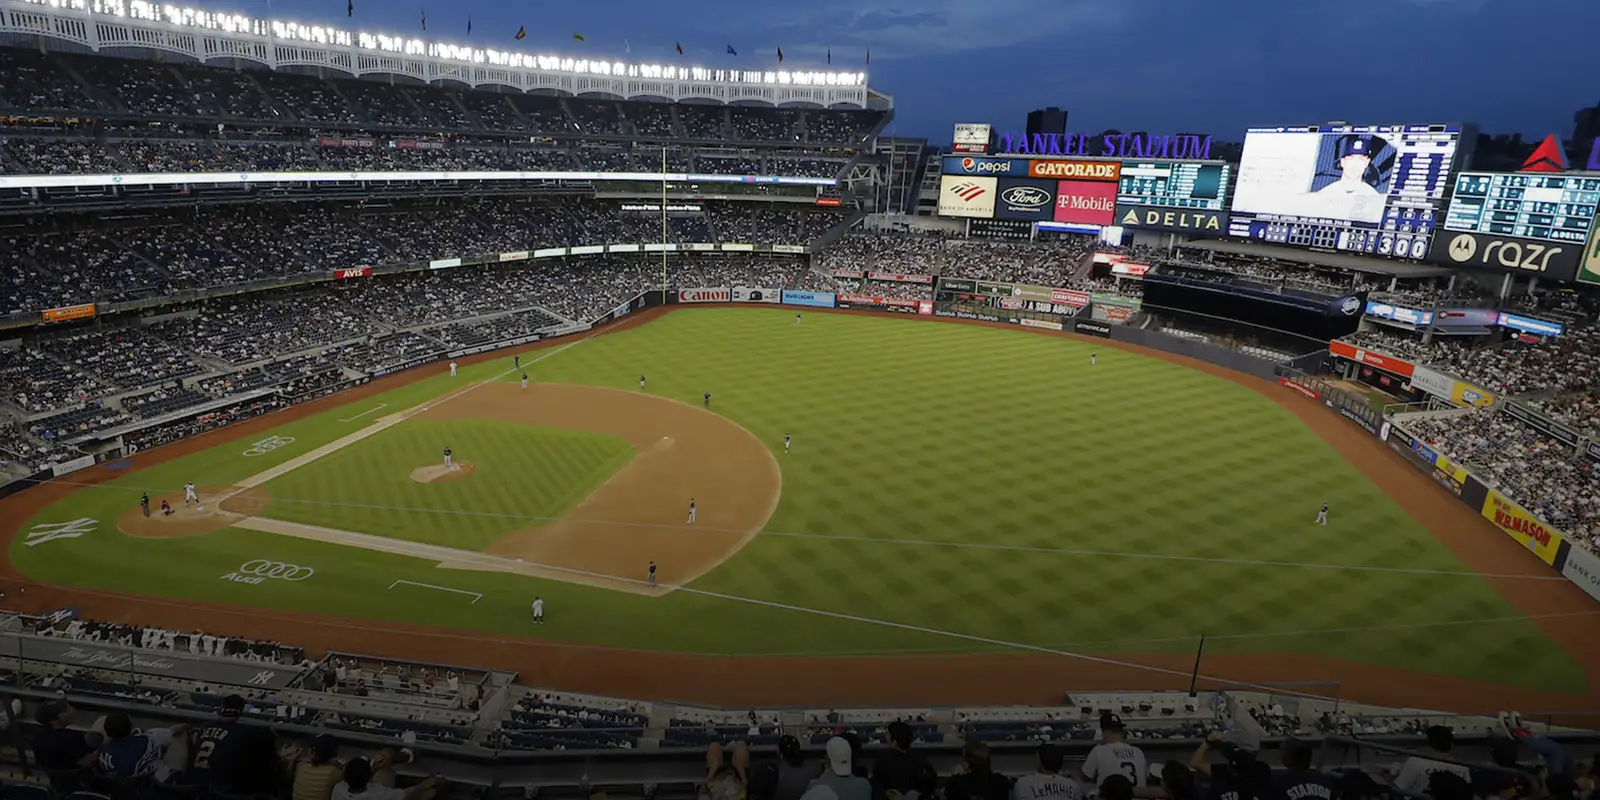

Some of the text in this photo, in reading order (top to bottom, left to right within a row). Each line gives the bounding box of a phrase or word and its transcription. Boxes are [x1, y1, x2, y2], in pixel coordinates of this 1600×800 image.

[1102, 134, 1212, 159] STADIUM
[977, 161, 1011, 173] pepsi
[1034, 163, 1115, 177] GATORADE
[1009, 188, 1041, 203] Ford
[1070, 195, 1114, 211] Mobile
[1146, 211, 1220, 230] DELTA
[1379, 237, 1425, 259] 3 0 0
[1482, 240, 1563, 272] razr
[343, 269, 364, 279] AVIS
[679, 290, 729, 301] Canon
[1035, 302, 1052, 314] SUB
[1568, 559, 1591, 577] BANK
[220, 572, 267, 585] Audi
[193, 739, 216, 770] 2
[1113, 748, 1135, 760] RUTH
[1120, 761, 1138, 787] 3
[1286, 781, 1331, 800] STANTON
